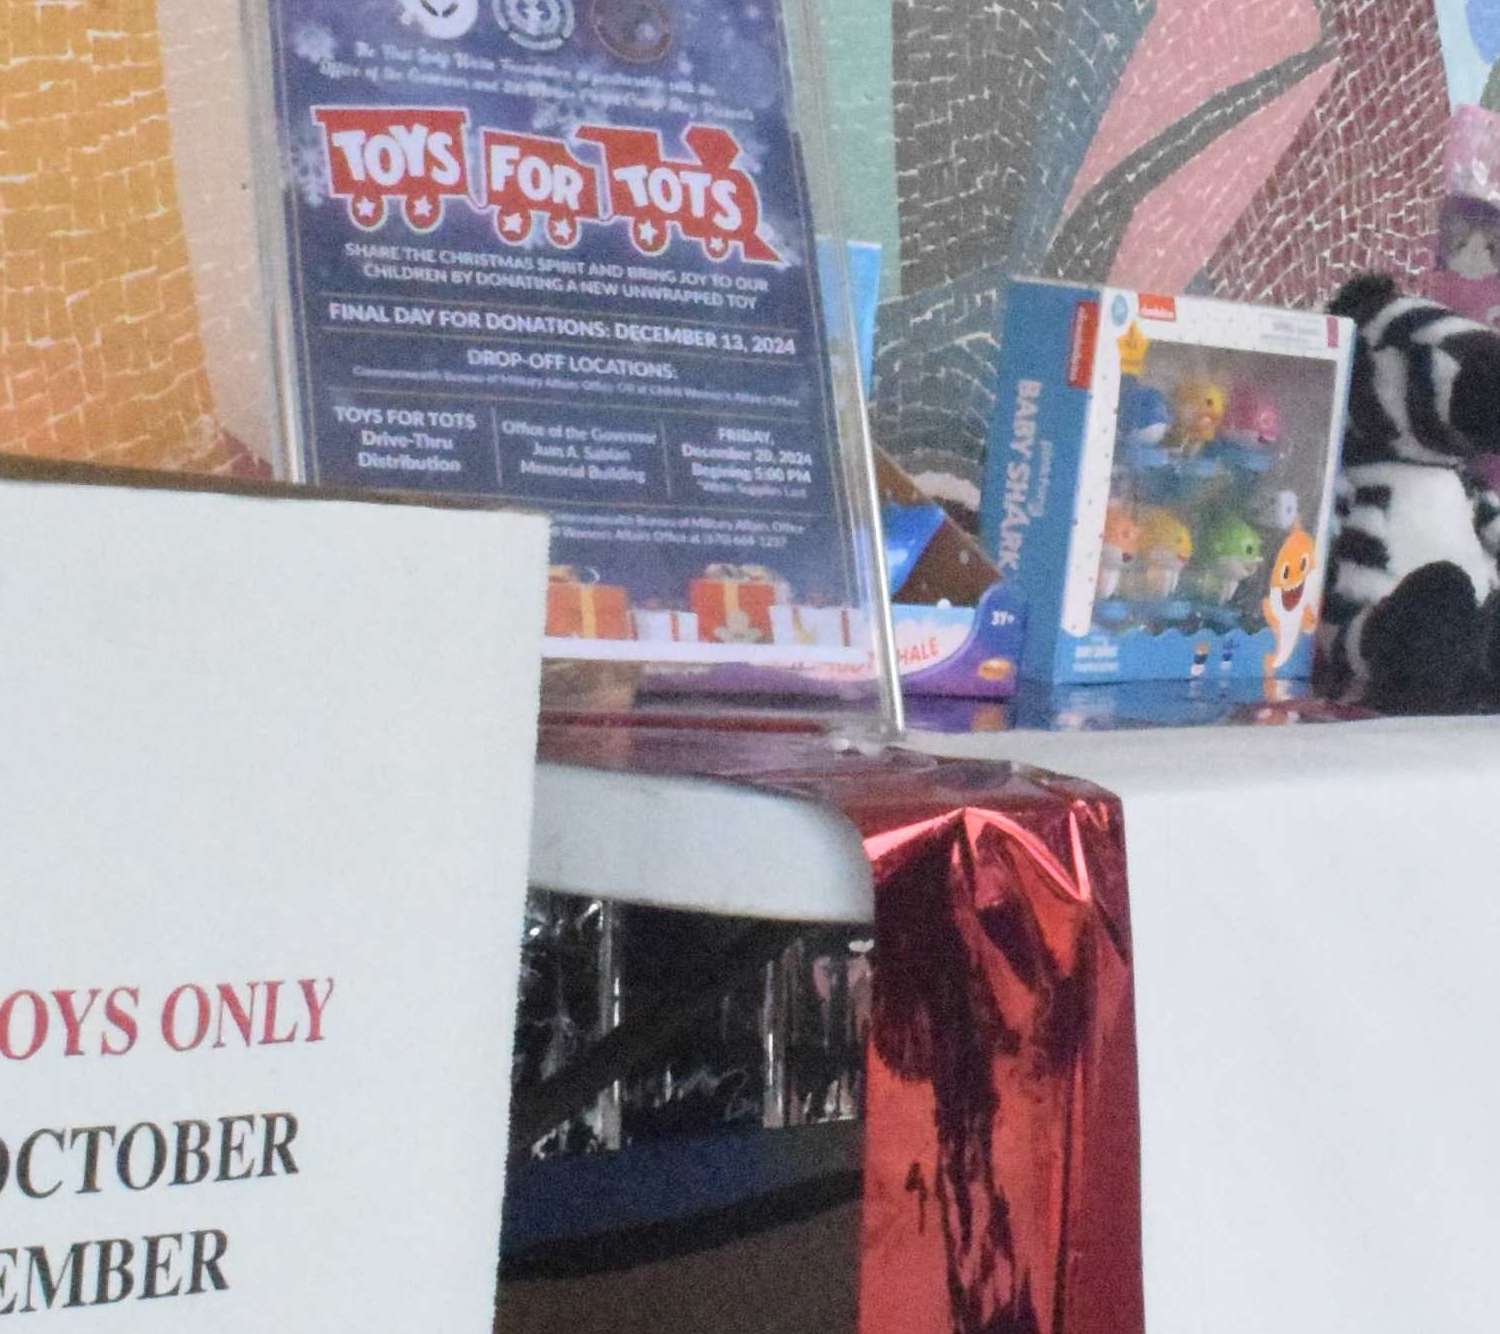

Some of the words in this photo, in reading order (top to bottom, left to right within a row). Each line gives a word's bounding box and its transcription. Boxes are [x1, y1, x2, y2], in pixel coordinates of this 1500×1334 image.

[331, 123, 460, 187] TOYS
[490, 144, 584, 210] FOR
[613, 166, 744, 231] TOTS
[345, 242, 400, 261] SHARE
[404, 246, 438, 263] THE
[439, 249, 534, 271] CHRISTMAS
[536, 256, 585, 274] SPIRIT
[588, 261, 624, 279] AND
[627, 266, 677, 284] BRING
[679, 271, 708, 287] JOY
[710, 273, 733, 289] TO
[735, 276, 770, 293] OUR
[363, 263, 449, 284] CHILDREN
[451, 269, 474, 285] BY
[475, 270, 564, 293] DONATING
[565, 279, 579, 293] A
[580, 280, 619, 297] NEW
[621, 283, 725, 308] UNWRAPPED
[726, 293, 758, 310] TOY
[329, 302, 390, 324] FINAL
[393, 306, 436, 326] DAY
[438, 310, 482, 330] FOR
[484, 312, 611, 339] DONATIONS:
[614, 322, 718, 349] DECEMBER
[720, 333, 749, 353] 13,
[751, 335, 797, 356] 2024
[466, 348, 565, 371] DROP-OFF
[569, 355, 679, 380] LOCATIONS:
[332, 406, 383, 424] TOYS
[386, 408, 425, 427] FOR
[427, 411, 477, 430] TOTS
[501, 420, 546, 437] Office
[547, 424, 563, 438] of
[565, 426, 588, 441] the
[590, 427, 657, 445] Governor
[1010, 378, 1043, 460] BABY
[361, 430, 454, 450] Drive-Thru
[681, 443, 752, 461] December
[779, 450, 813, 467] 2024
[357, 451, 462, 472] Distribution
[520, 459, 586, 479] Memorial
[588, 464, 647, 485] Building
[998, 462, 1032, 570] SHARK
[160, 976, 336, 1056] ONLY
